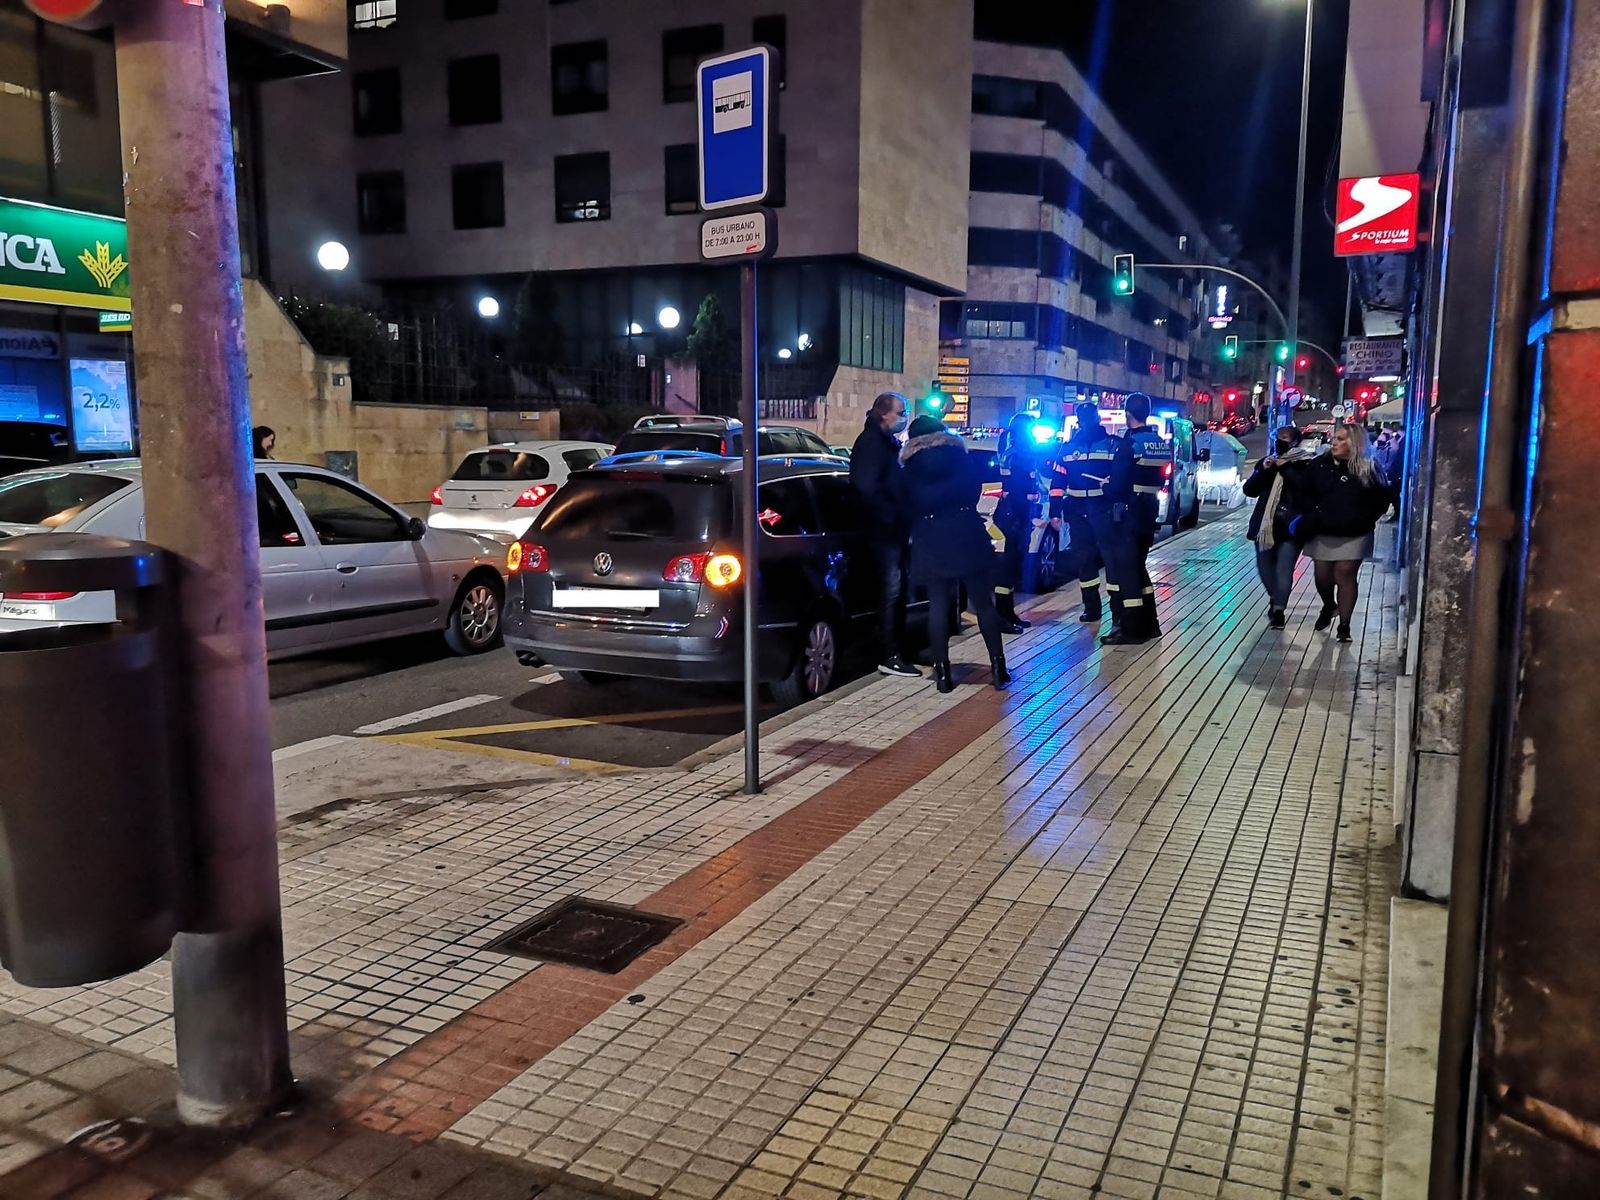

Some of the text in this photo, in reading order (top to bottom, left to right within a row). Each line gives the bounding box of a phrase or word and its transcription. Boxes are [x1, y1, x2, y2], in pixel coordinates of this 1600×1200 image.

[711, 220, 755, 235] BUS URBANO
[705, 239, 714, 247] DE
[755, 232, 760, 240] H
[1344, 229, 1409, 242] SPORTIUM
[0, 231, 66, 274] CA
[1356, 350, 1393, 359] CHINO
[82, 392, 121, 411] 2,2%
[1029, 398, 1039, 410] P
